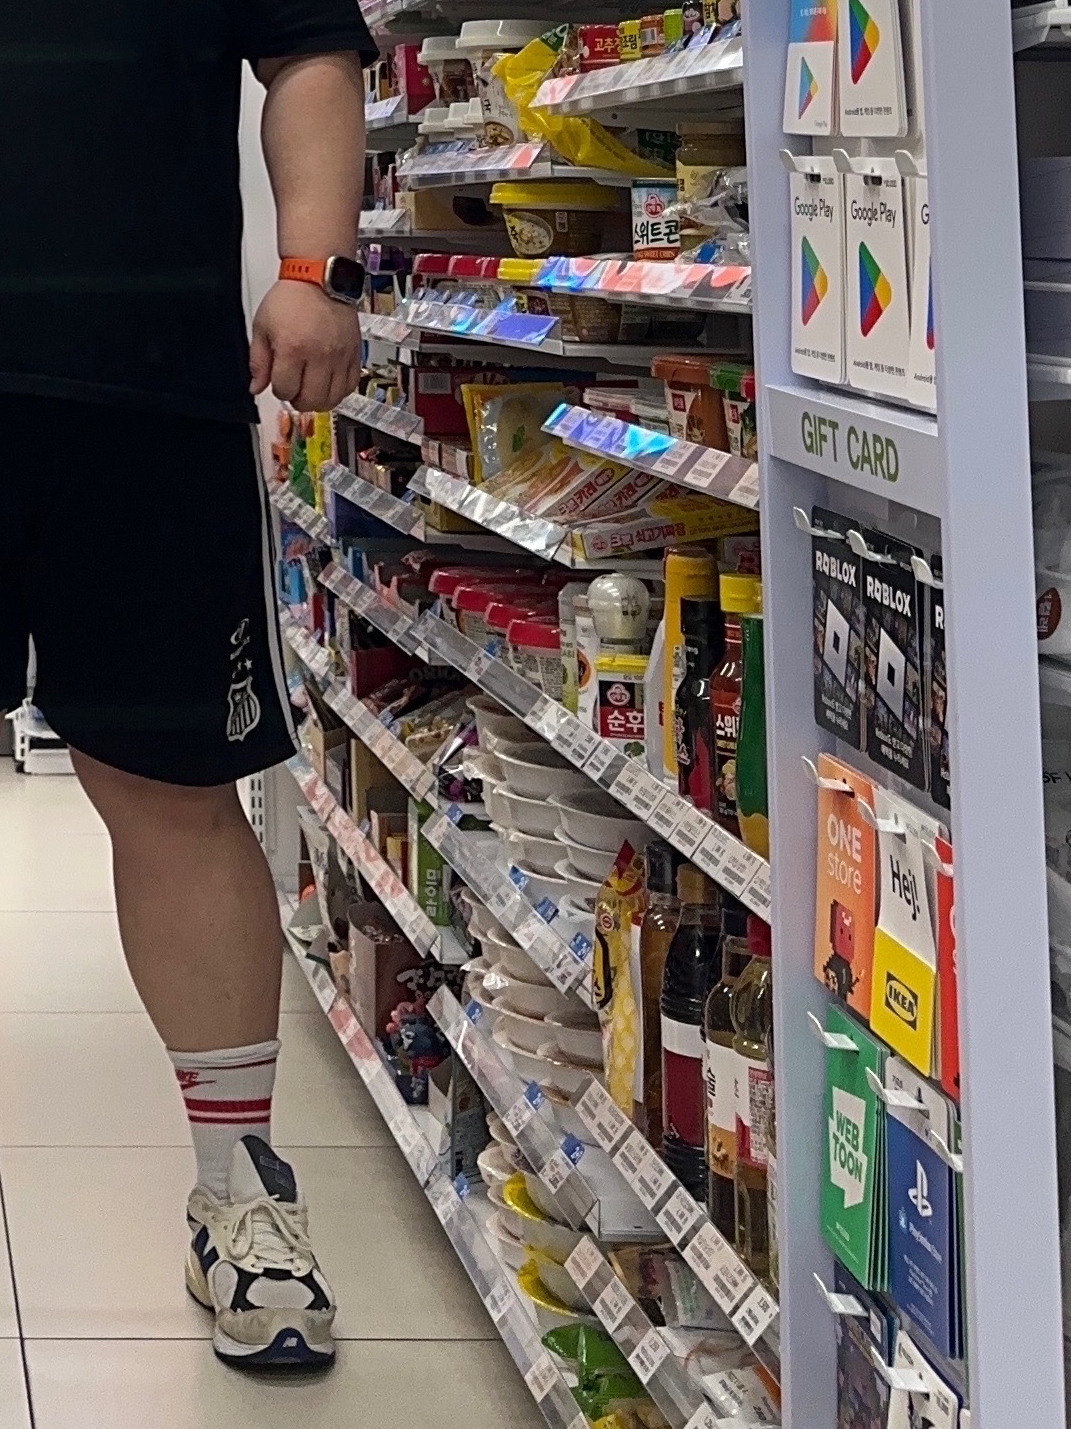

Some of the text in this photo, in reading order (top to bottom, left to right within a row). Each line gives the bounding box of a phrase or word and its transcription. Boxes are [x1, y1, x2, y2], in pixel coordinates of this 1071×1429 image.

[794, 196, 834, 223] Google Play
[850, 199, 878, 227] Google
[879, 201, 897, 228] Play
[634, 219, 679, 245] 스위트콘
[801, 411, 899, 483] GIFT CARD
[815, 550, 857, 588] ROBLOX
[866, 574, 911, 618] ROBLOX
[607, 710, 644, 732] 순후
[827, 812, 862, 865] ONE
[827, 851, 863, 895] store
[889, 853, 920, 922] Hej!
[887, 979, 917, 1018] IKEA
[836, 1109, 860, 1153] WEB
[832, 1132, 862, 1185] TOON
